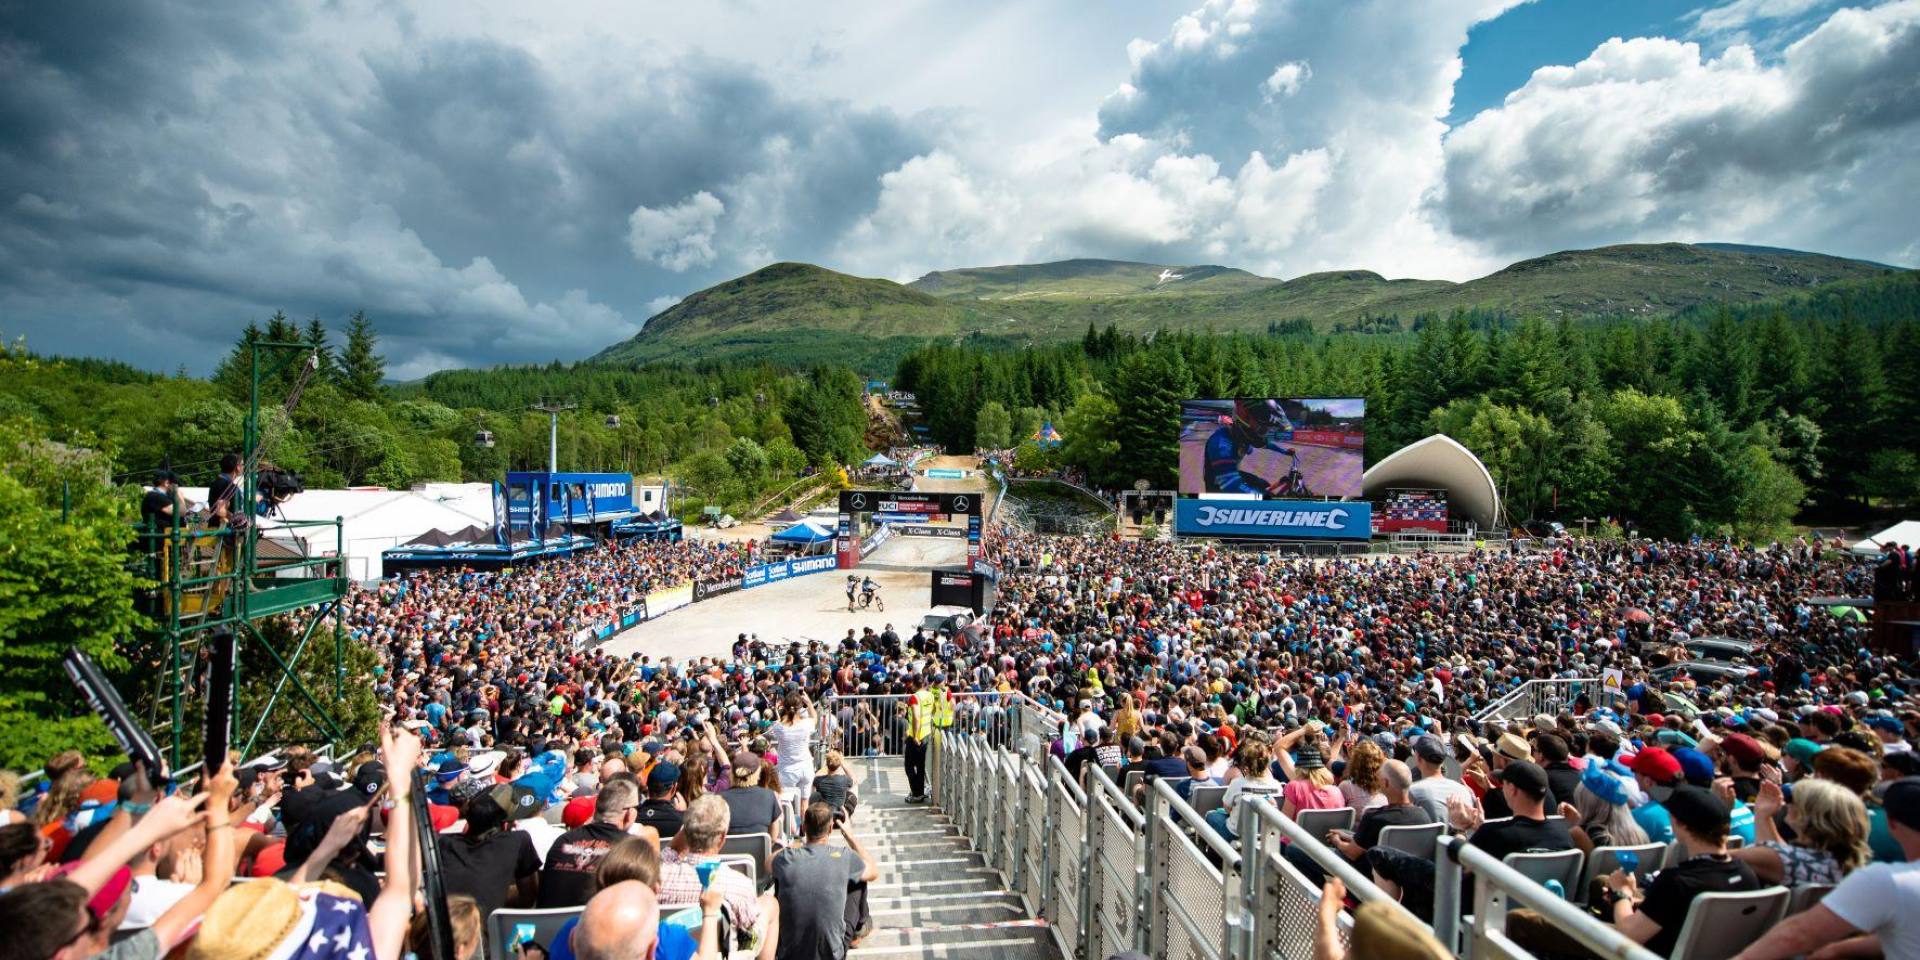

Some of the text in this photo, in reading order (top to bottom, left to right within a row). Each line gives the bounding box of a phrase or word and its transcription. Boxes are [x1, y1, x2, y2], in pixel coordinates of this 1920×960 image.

[907, 527, 932, 535] X-Class
[936, 528, 961, 536] X-Class
[791, 557, 836, 574] SHIMANO
